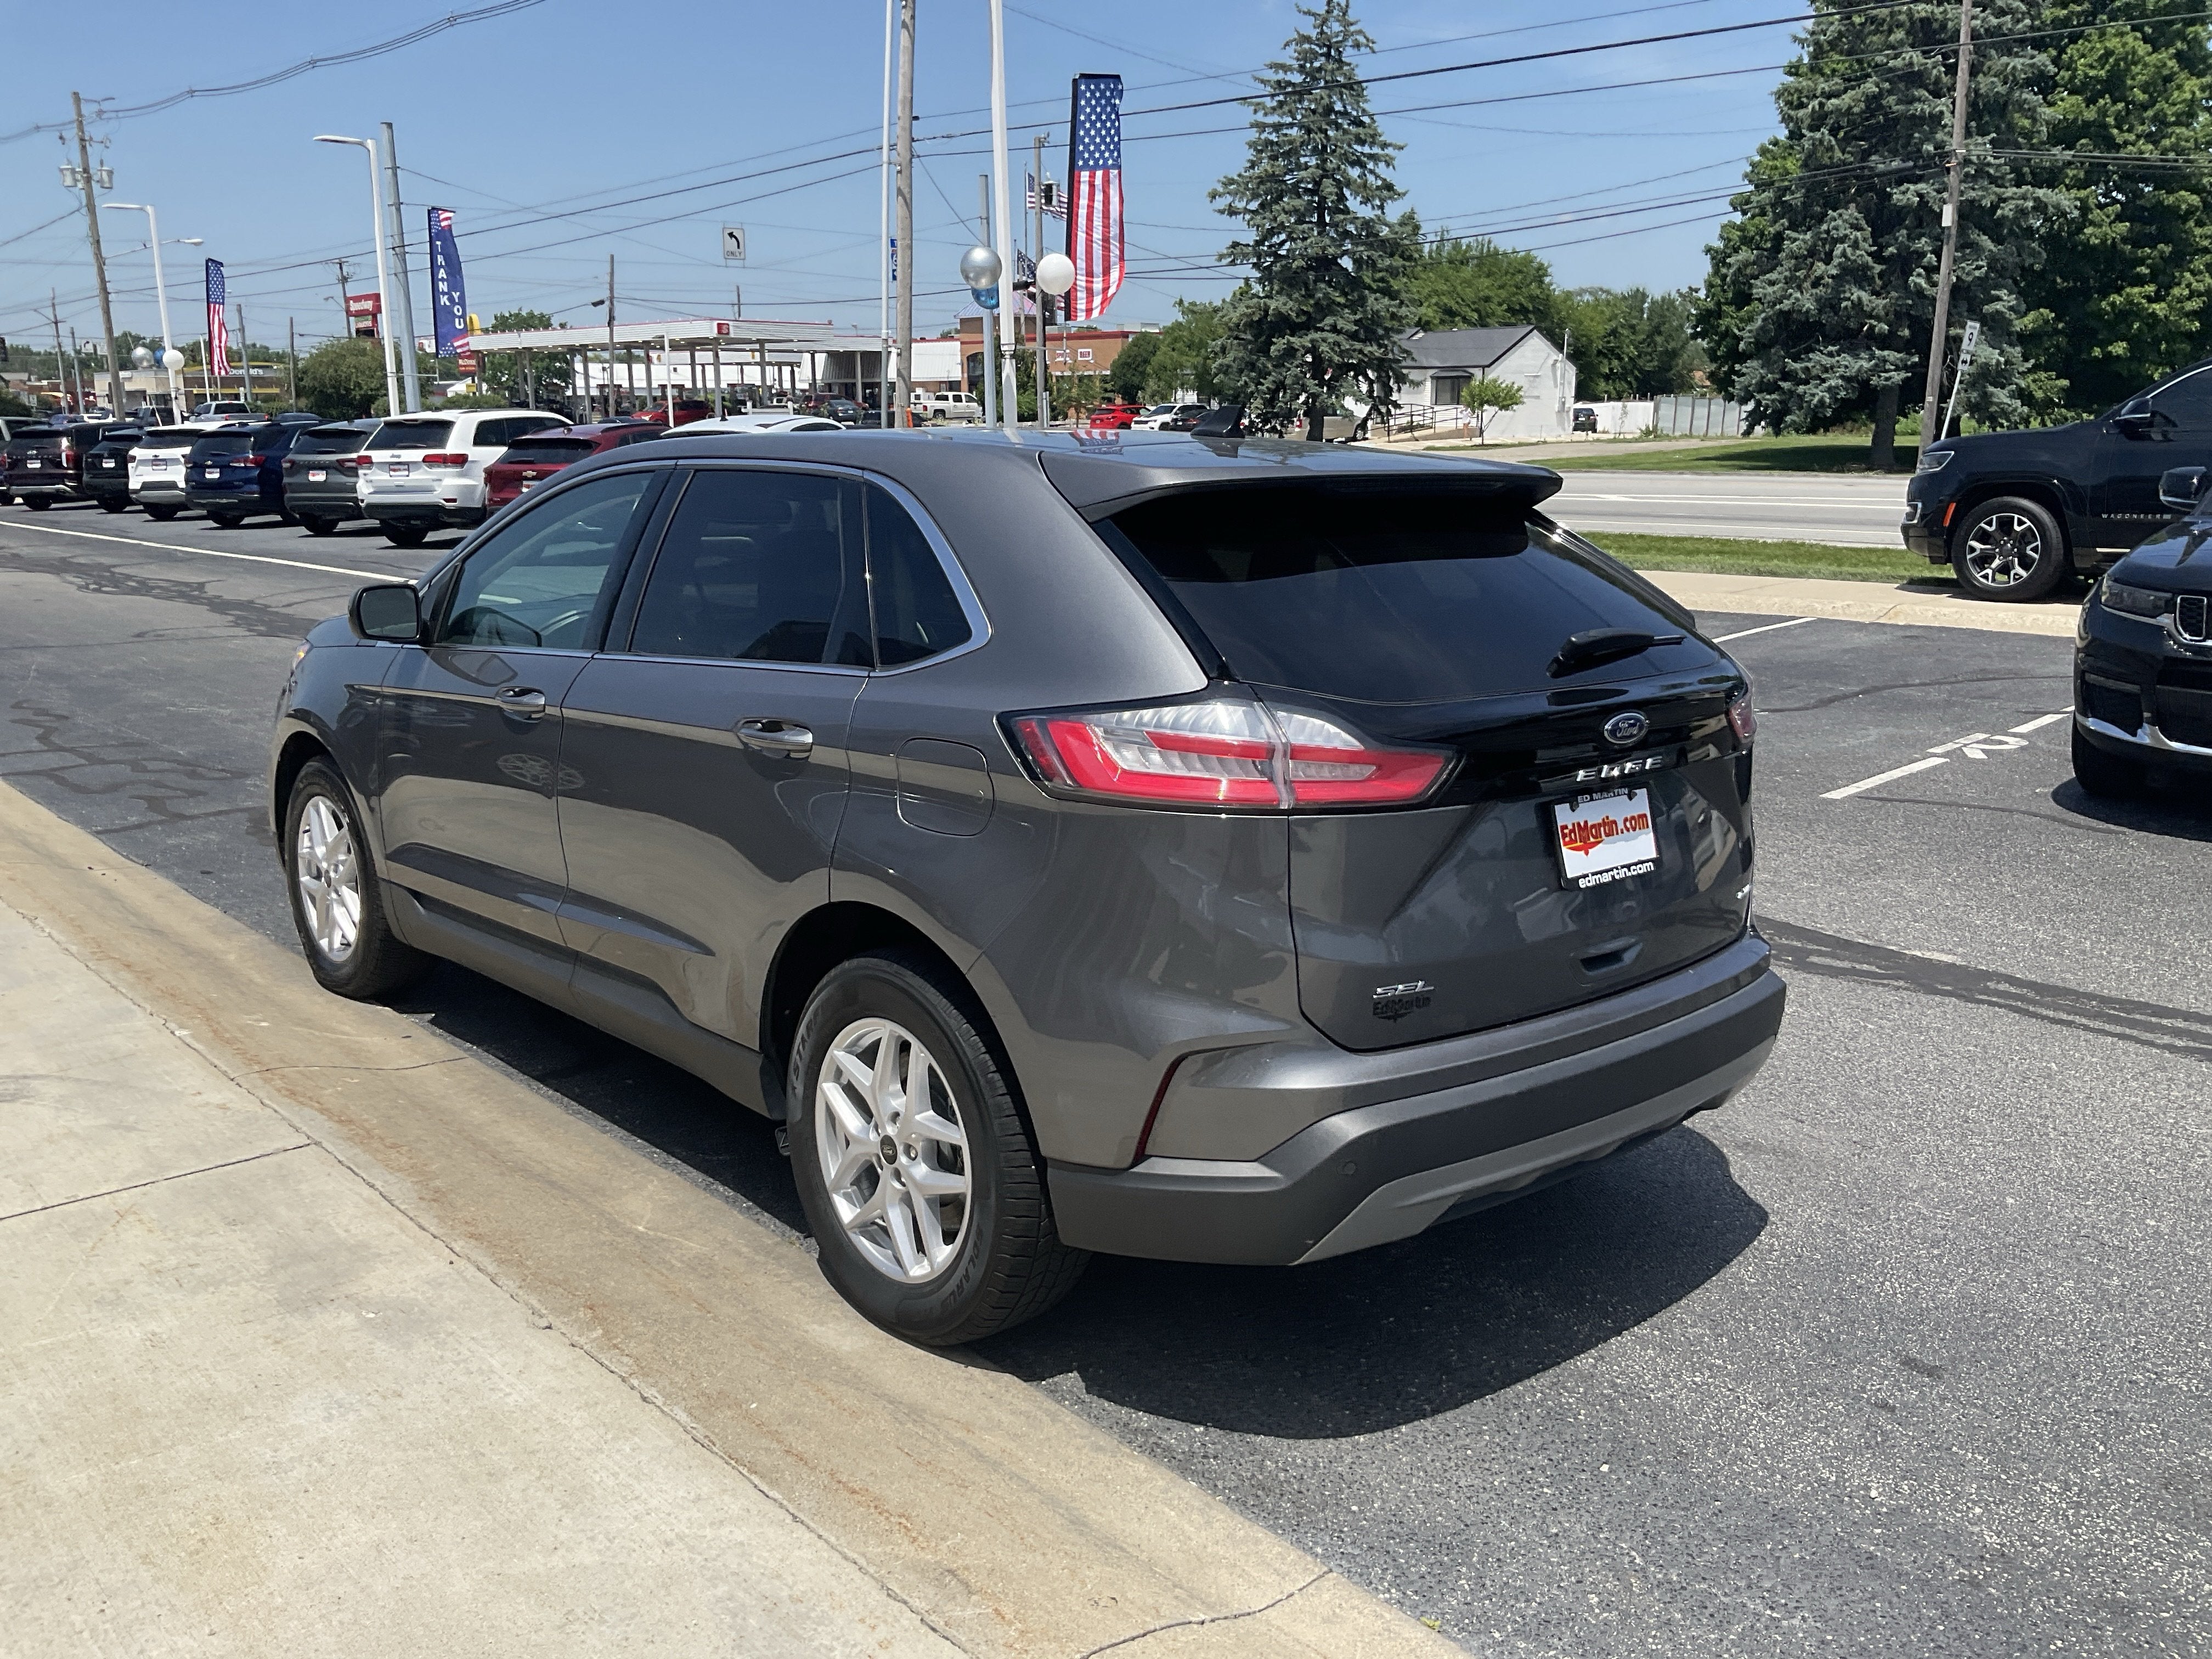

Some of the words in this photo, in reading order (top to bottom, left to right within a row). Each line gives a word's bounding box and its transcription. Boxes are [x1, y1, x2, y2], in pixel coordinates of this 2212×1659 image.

[436, 241, 450, 306] THANK
[452, 291, 464, 329] YOU
[1968, 332, 1973, 346] 9
[1616, 719, 1640, 737] Ford
[1576, 755, 1663, 782] EDGE
[1577, 794, 1590, 803] ED
[1592, 787, 1628, 801] MARTIN
[1559, 812, 1649, 844] EdMartin.com
[1578, 861, 1655, 889] edmartin.com
[1373, 980, 1435, 998] SEL
